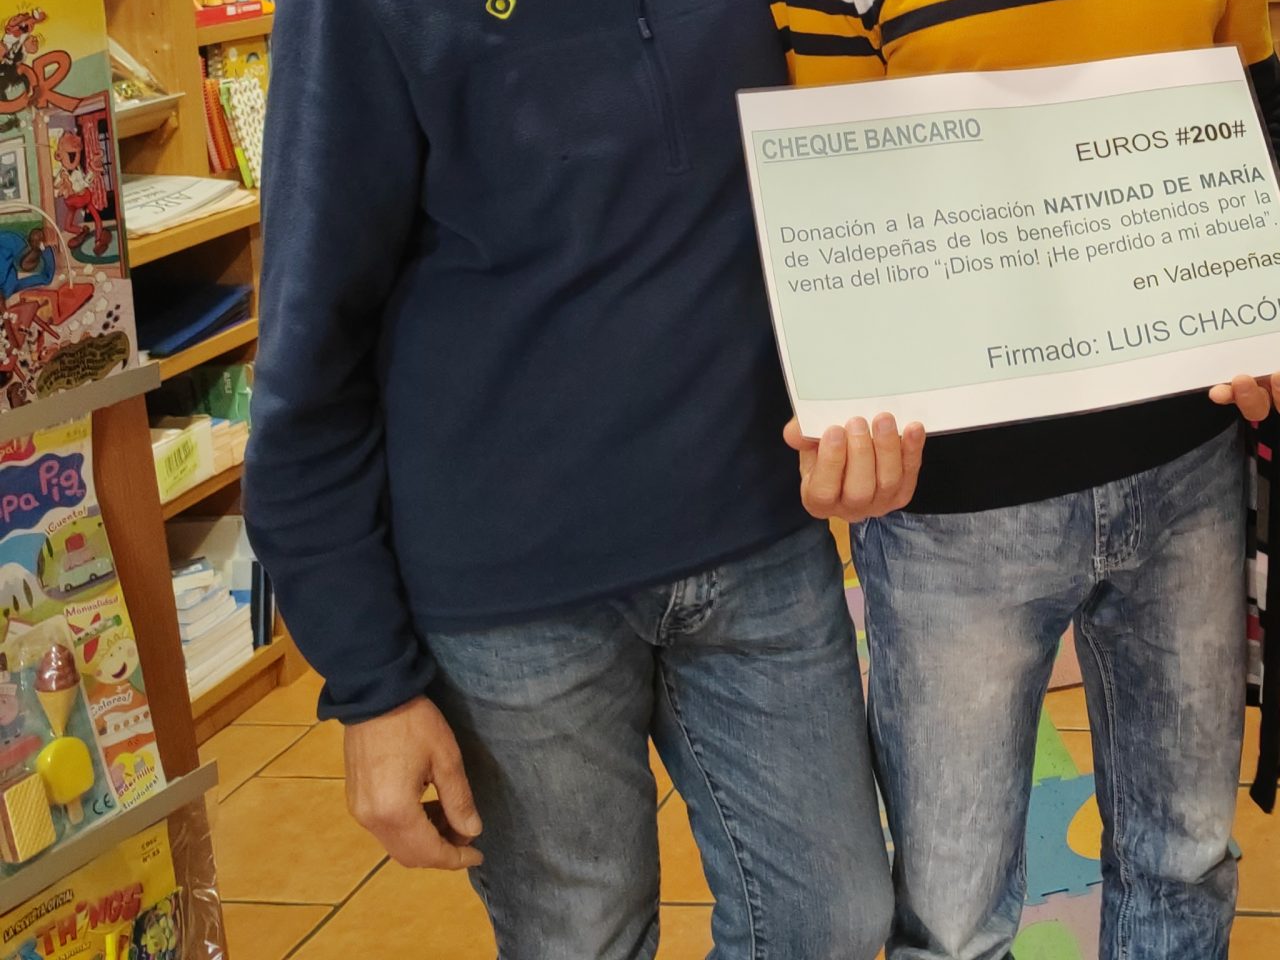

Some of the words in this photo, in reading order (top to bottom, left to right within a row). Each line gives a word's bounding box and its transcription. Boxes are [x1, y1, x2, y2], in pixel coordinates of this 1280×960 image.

[762, 131, 859, 160] CHEQUE
[864, 117, 982, 150] BANCARIO
[1075, 131, 1169, 162] EUROS
[1175, 120, 1247, 146] #200#
[780, 219, 876, 244] Donación
[886, 218, 898, 232] a
[907, 213, 925, 230] la
[933, 201, 1035, 227] Asociación
[1043, 183, 1155, 215] NATIVIDAD
[1163, 176, 1193, 196] DE
[1199, 164, 1266, 190] MARÍA
[784, 251, 809, 268] de
[819, 238, 937, 266] Valdepeñas
[947, 232, 972, 250] de
[981, 229, 1008, 246] los
[1017, 215, 1112, 243] beneficios
[1120, 200, 1210, 227] obtenidos
[1218, 193, 1247, 214] por
[1254, 189, 1272, 206] la
[788, 274, 844, 293] venta
[850, 267, 881, 288] del
[886, 262, 930, 284] libro
[1000, 248, 1040, 269] mío!
[1047, 246, 1080, 269] ¡He
[1085, 231, 1156, 263] perdido
[1161, 231, 1173, 245] a
[1178, 223, 1201, 242] mi
[1133, 273, 1160, 290] en
[987, 336, 1101, 369] Firmado:
[1107, 320, 1171, 352] LUIS
[39, 459, 81, 502] Pig
